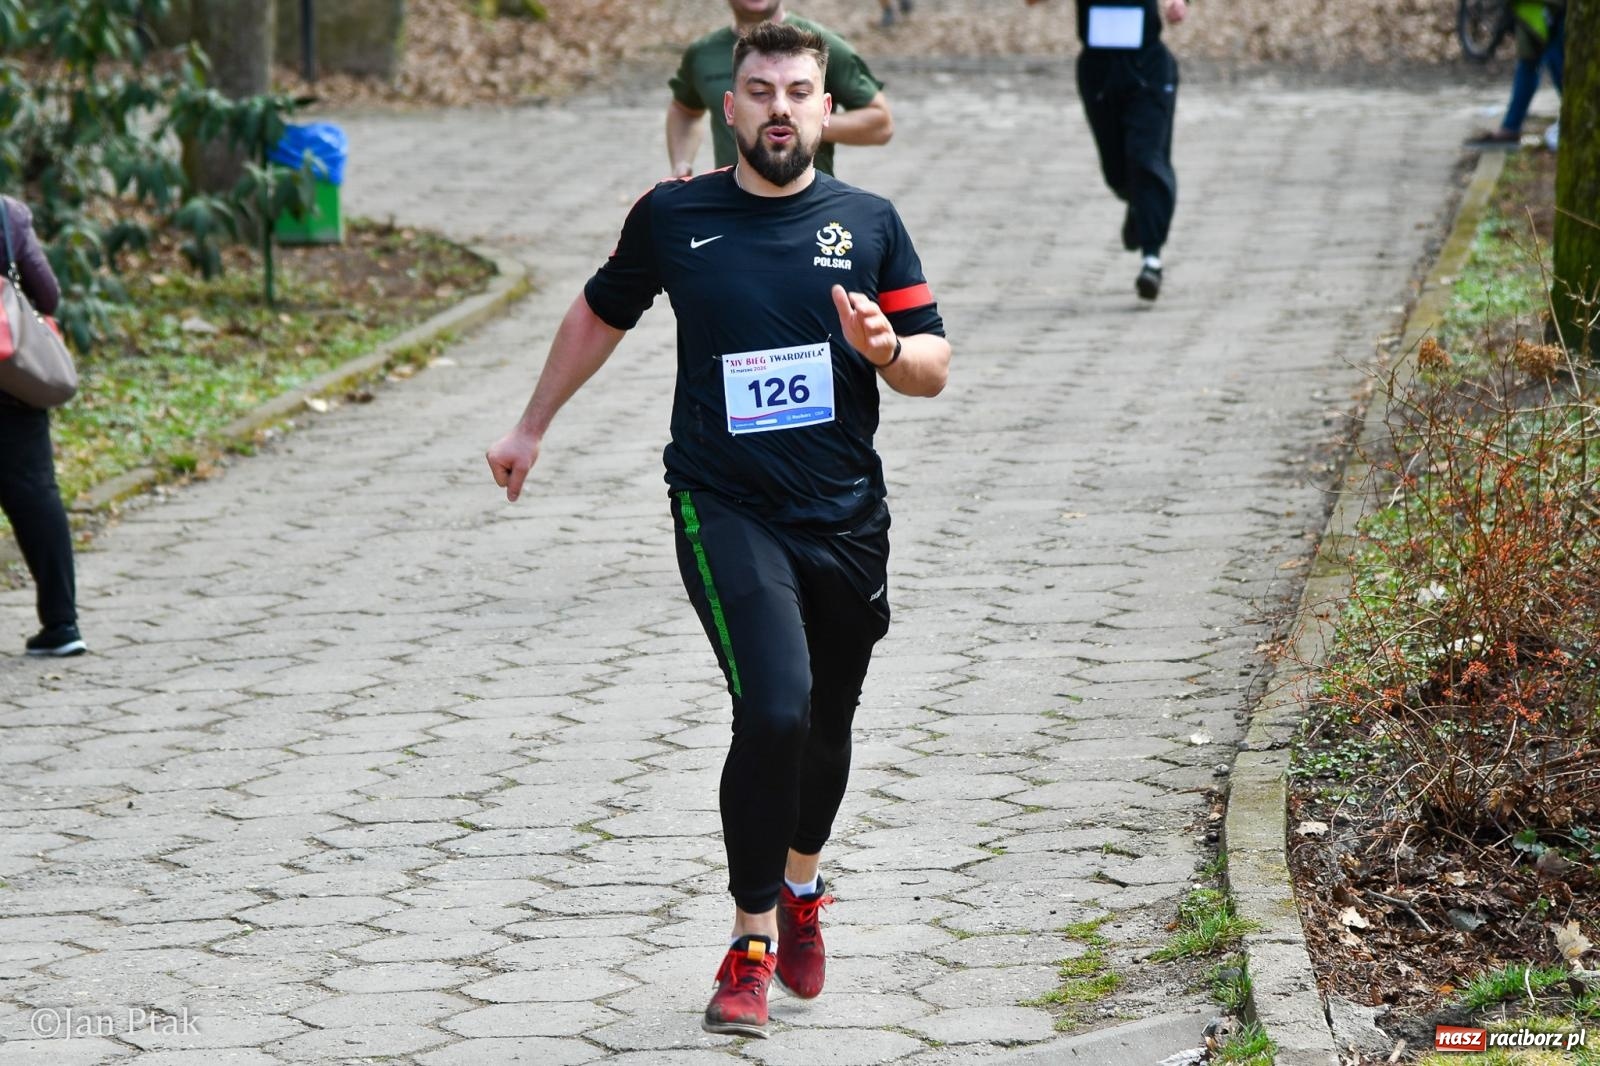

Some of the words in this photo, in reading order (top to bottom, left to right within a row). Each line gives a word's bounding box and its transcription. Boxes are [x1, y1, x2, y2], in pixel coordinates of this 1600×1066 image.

[813, 256, 852, 270] POLSKA
[730, 359, 743, 367] XIV
[745, 356, 767, 366] BIEG
[769, 350, 823, 363] TWARDZIELA
[748, 374, 810, 408] 126
